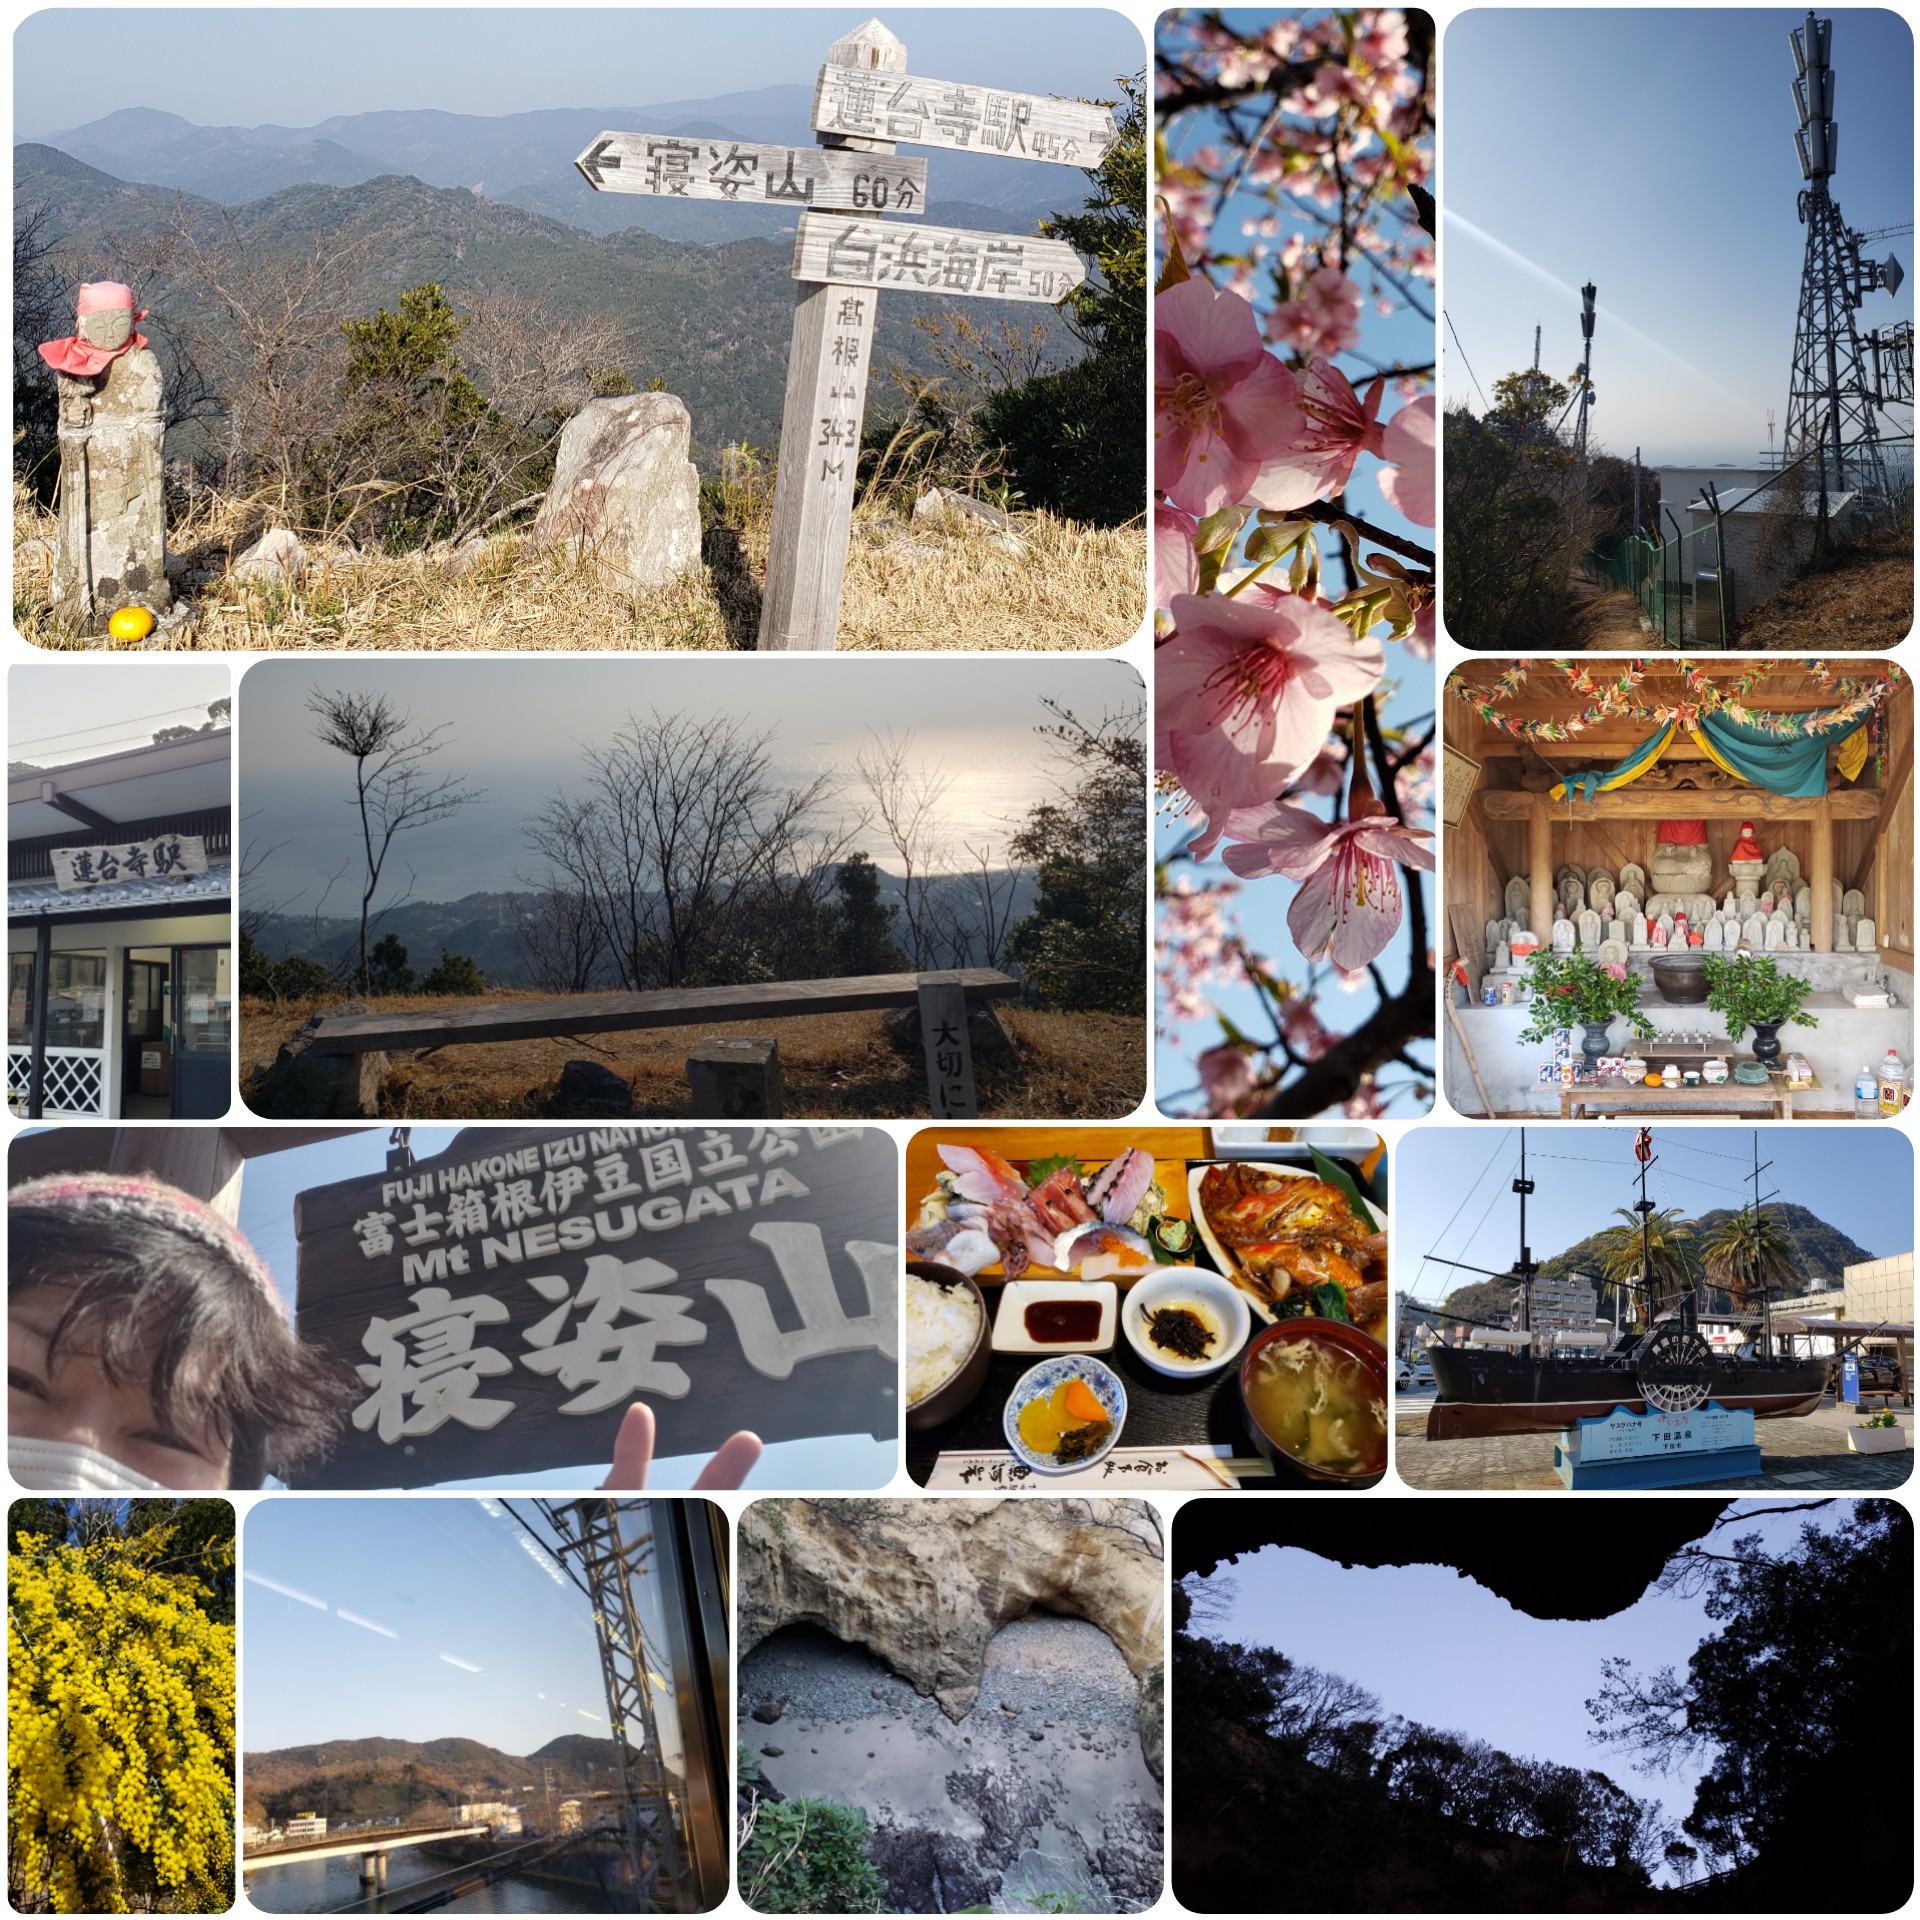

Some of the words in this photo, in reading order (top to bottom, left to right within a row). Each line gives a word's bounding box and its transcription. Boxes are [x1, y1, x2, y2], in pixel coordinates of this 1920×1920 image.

[645, 139, 814, 204] 寝姿山
[852, 174, 921, 208] 60分
[827, 224, 1025, 293] 白浜海岸
[818, 418, 857, 448] 343
[821, 459, 844, 482] M
[70, 841, 187, 883] 蓮台寺駅
[932, 1020, 967, 1119] 大切に
[382, 1172, 435, 1207] FUJI
[439, 1146, 541, 1194] HAKONE
[543, 1134, 587, 1168] IZU
[403, 1244, 471, 1286] Mt
[481, 1167, 810, 1269] NESUGATA
[351, 1221, 898, 1445] 寝姿山
[1652, 1431, 1692, 1442] 下田温泉
